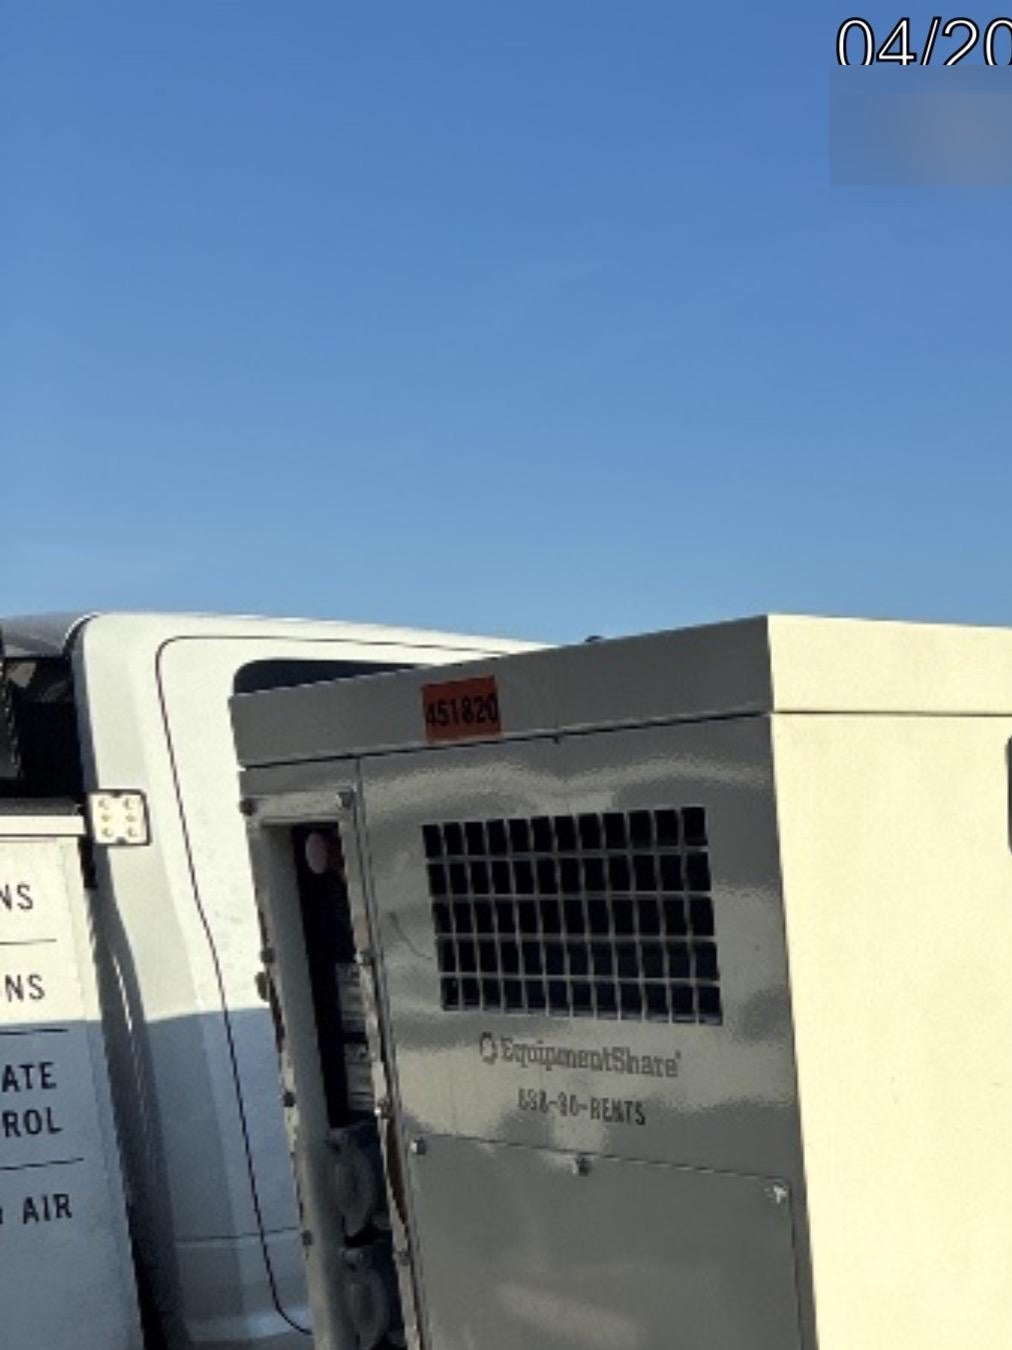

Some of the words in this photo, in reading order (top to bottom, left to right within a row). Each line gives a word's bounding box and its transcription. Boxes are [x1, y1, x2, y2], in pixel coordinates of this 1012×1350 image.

[5, 973, 46, 1003] NS
[2, 1061, 57, 1093] ATE
[1, 1106, 65, 1138] ROL
[22, 1193, 73, 1225] AIR
